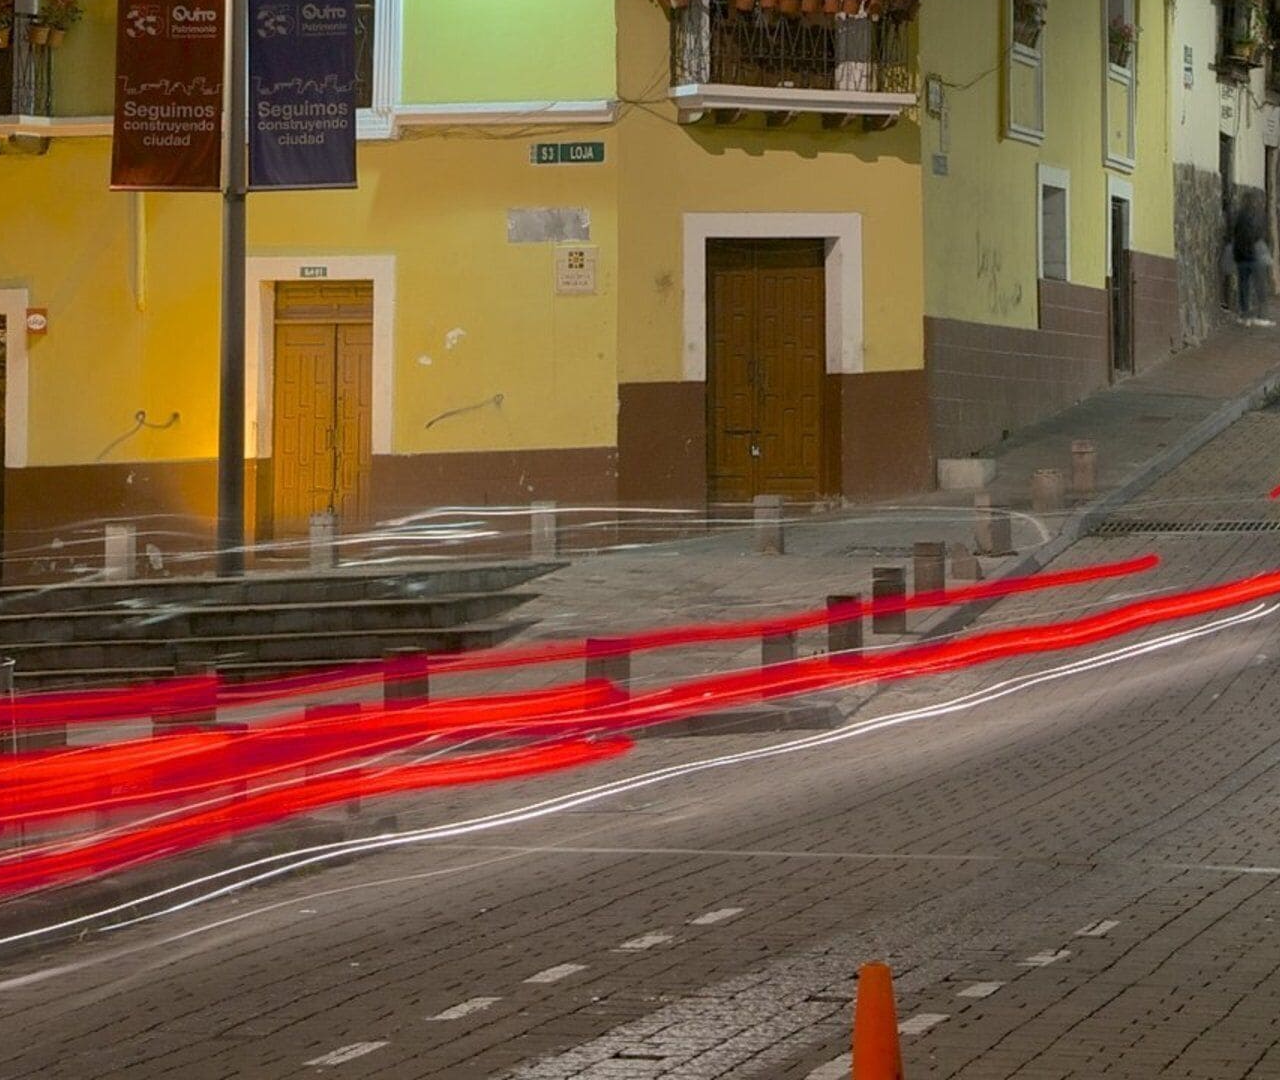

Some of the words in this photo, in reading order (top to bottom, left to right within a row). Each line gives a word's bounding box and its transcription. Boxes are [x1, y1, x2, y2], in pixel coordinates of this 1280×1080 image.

[123, 101, 215, 119] Seguimos
[257, 101, 348, 119] Seguimos
[123, 120, 215, 132] construyendo
[257, 119, 348, 132] construyendo
[143, 133, 191, 146] ciudad
[278, 133, 325, 146] ciudad
[542, 148, 554, 160] S3
[570, 147, 594, 160] LOJA
